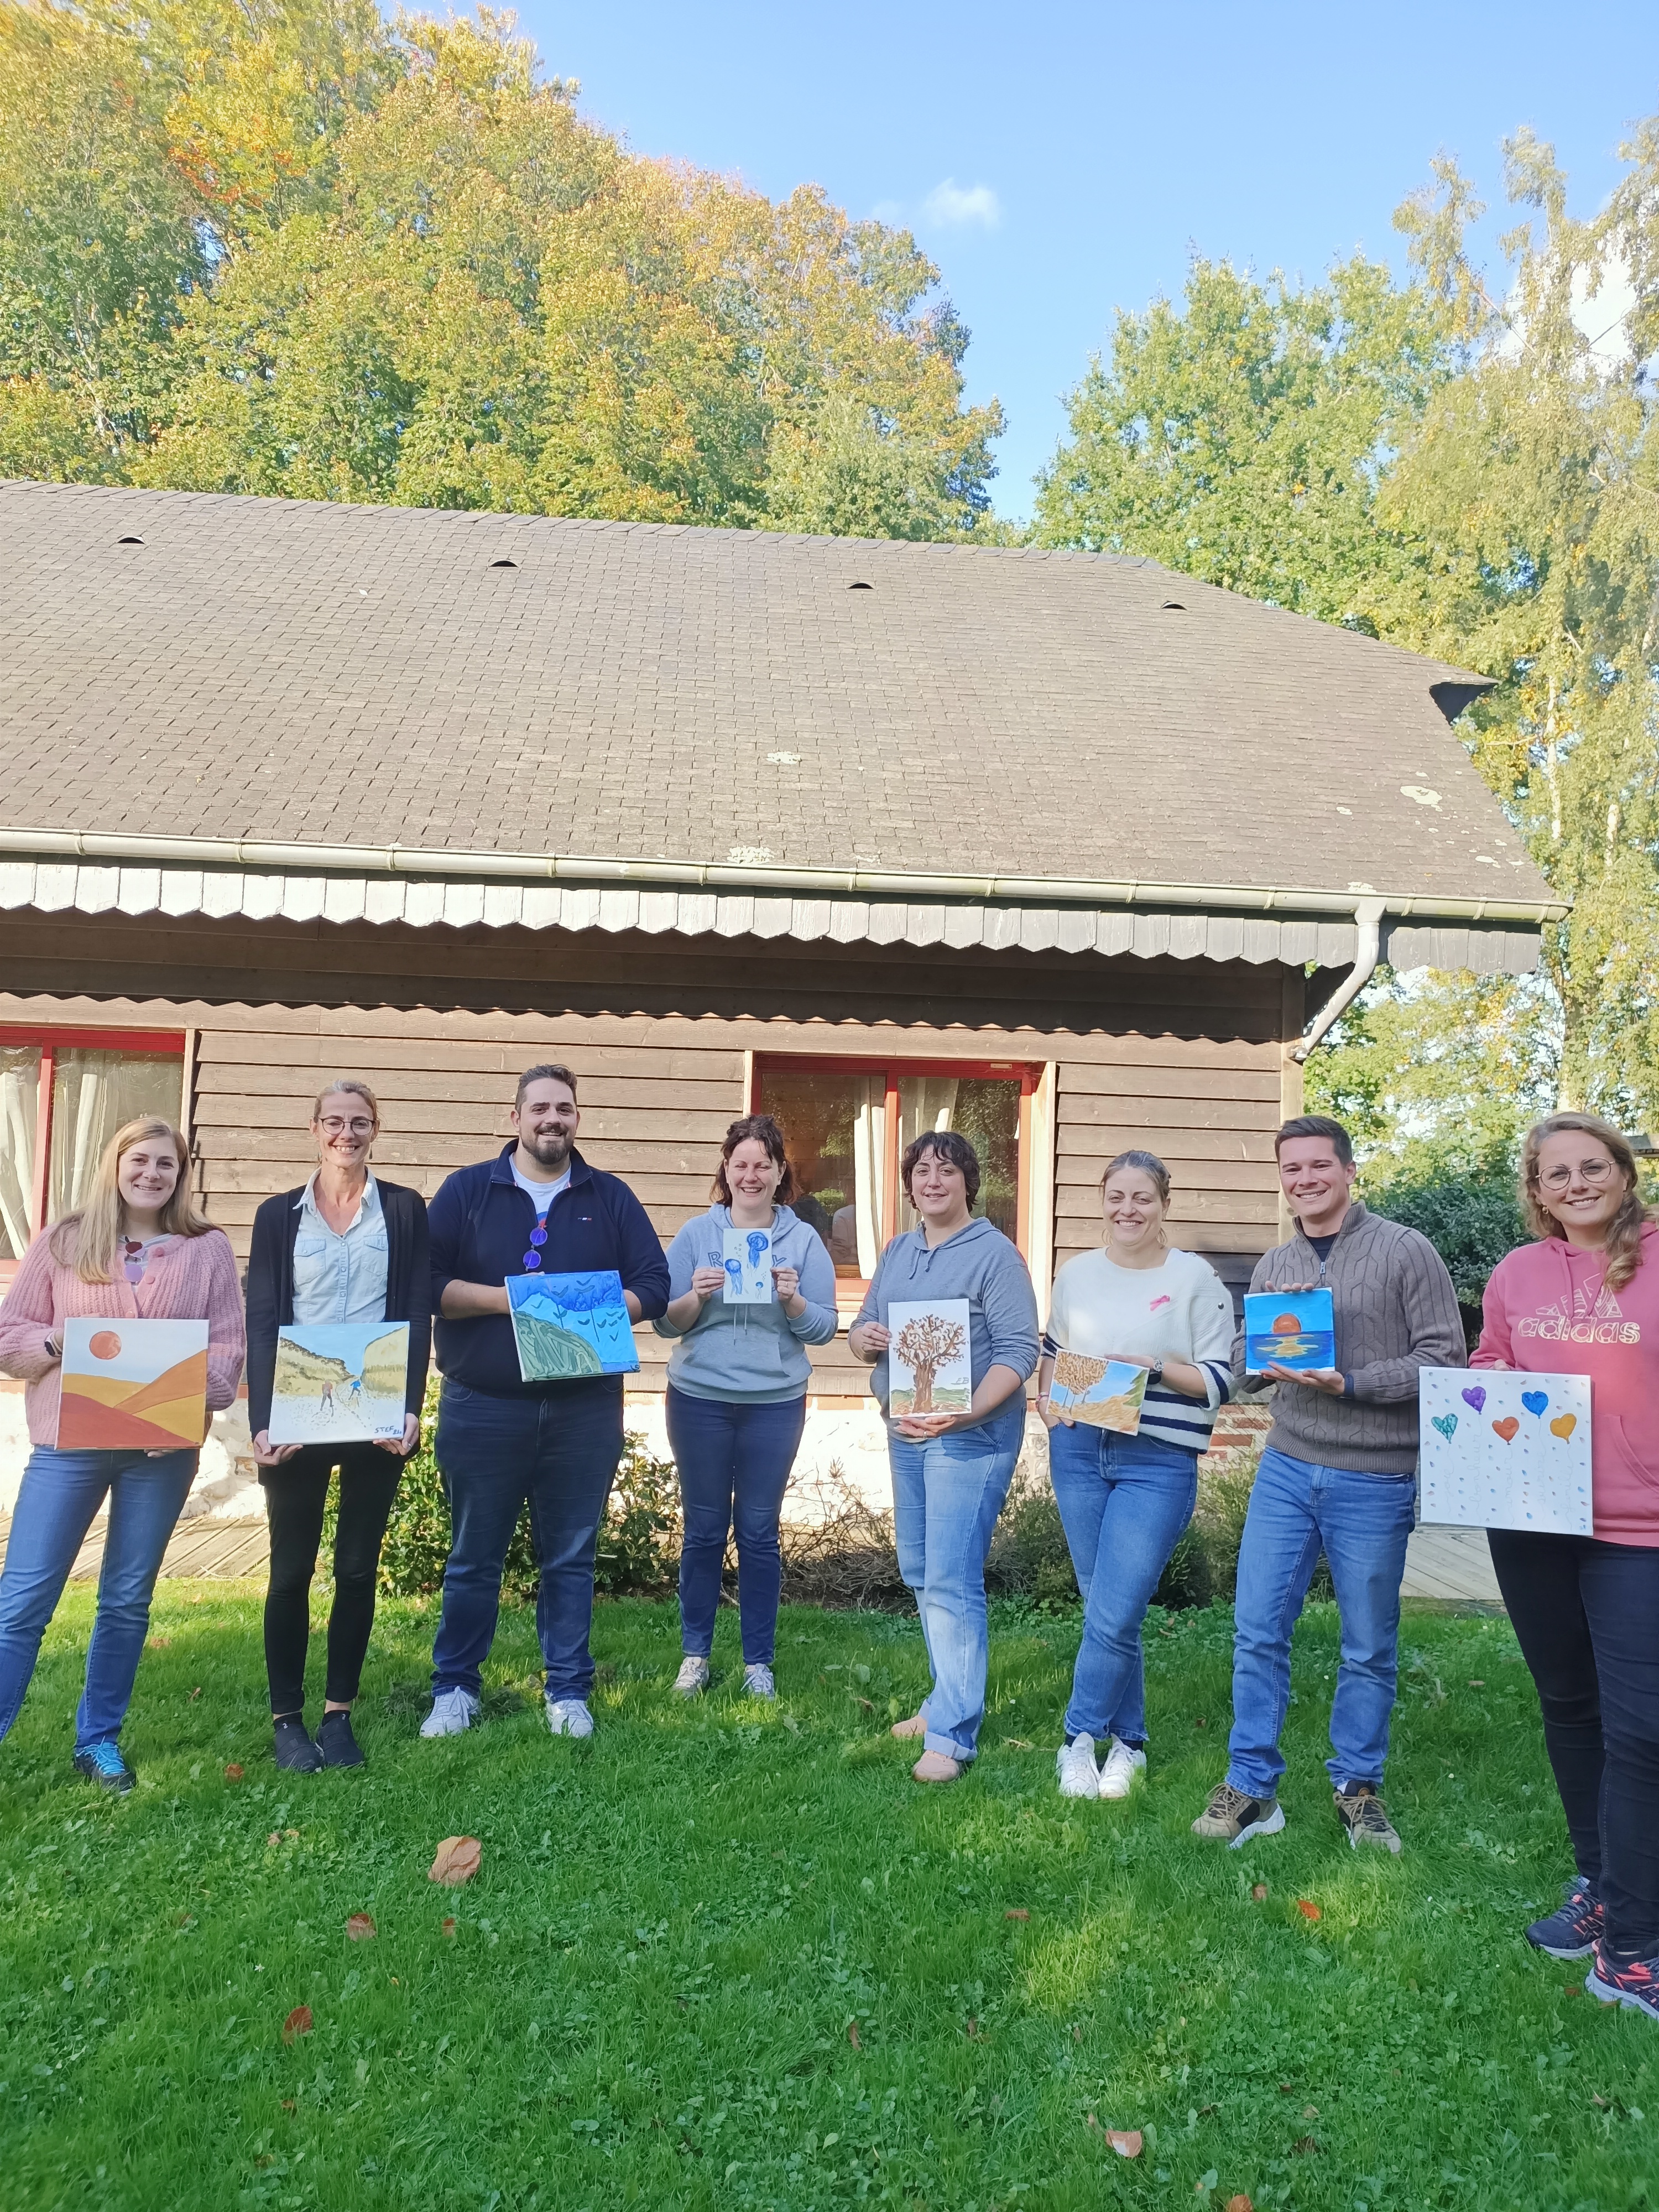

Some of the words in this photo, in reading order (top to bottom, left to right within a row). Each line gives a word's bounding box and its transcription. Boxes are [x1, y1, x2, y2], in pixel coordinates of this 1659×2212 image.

[1518, 1315, 1641, 1344] adidas
[374, 1425, 394, 1434] STEF
[1467, 1433, 1482, 1503] bonheur
